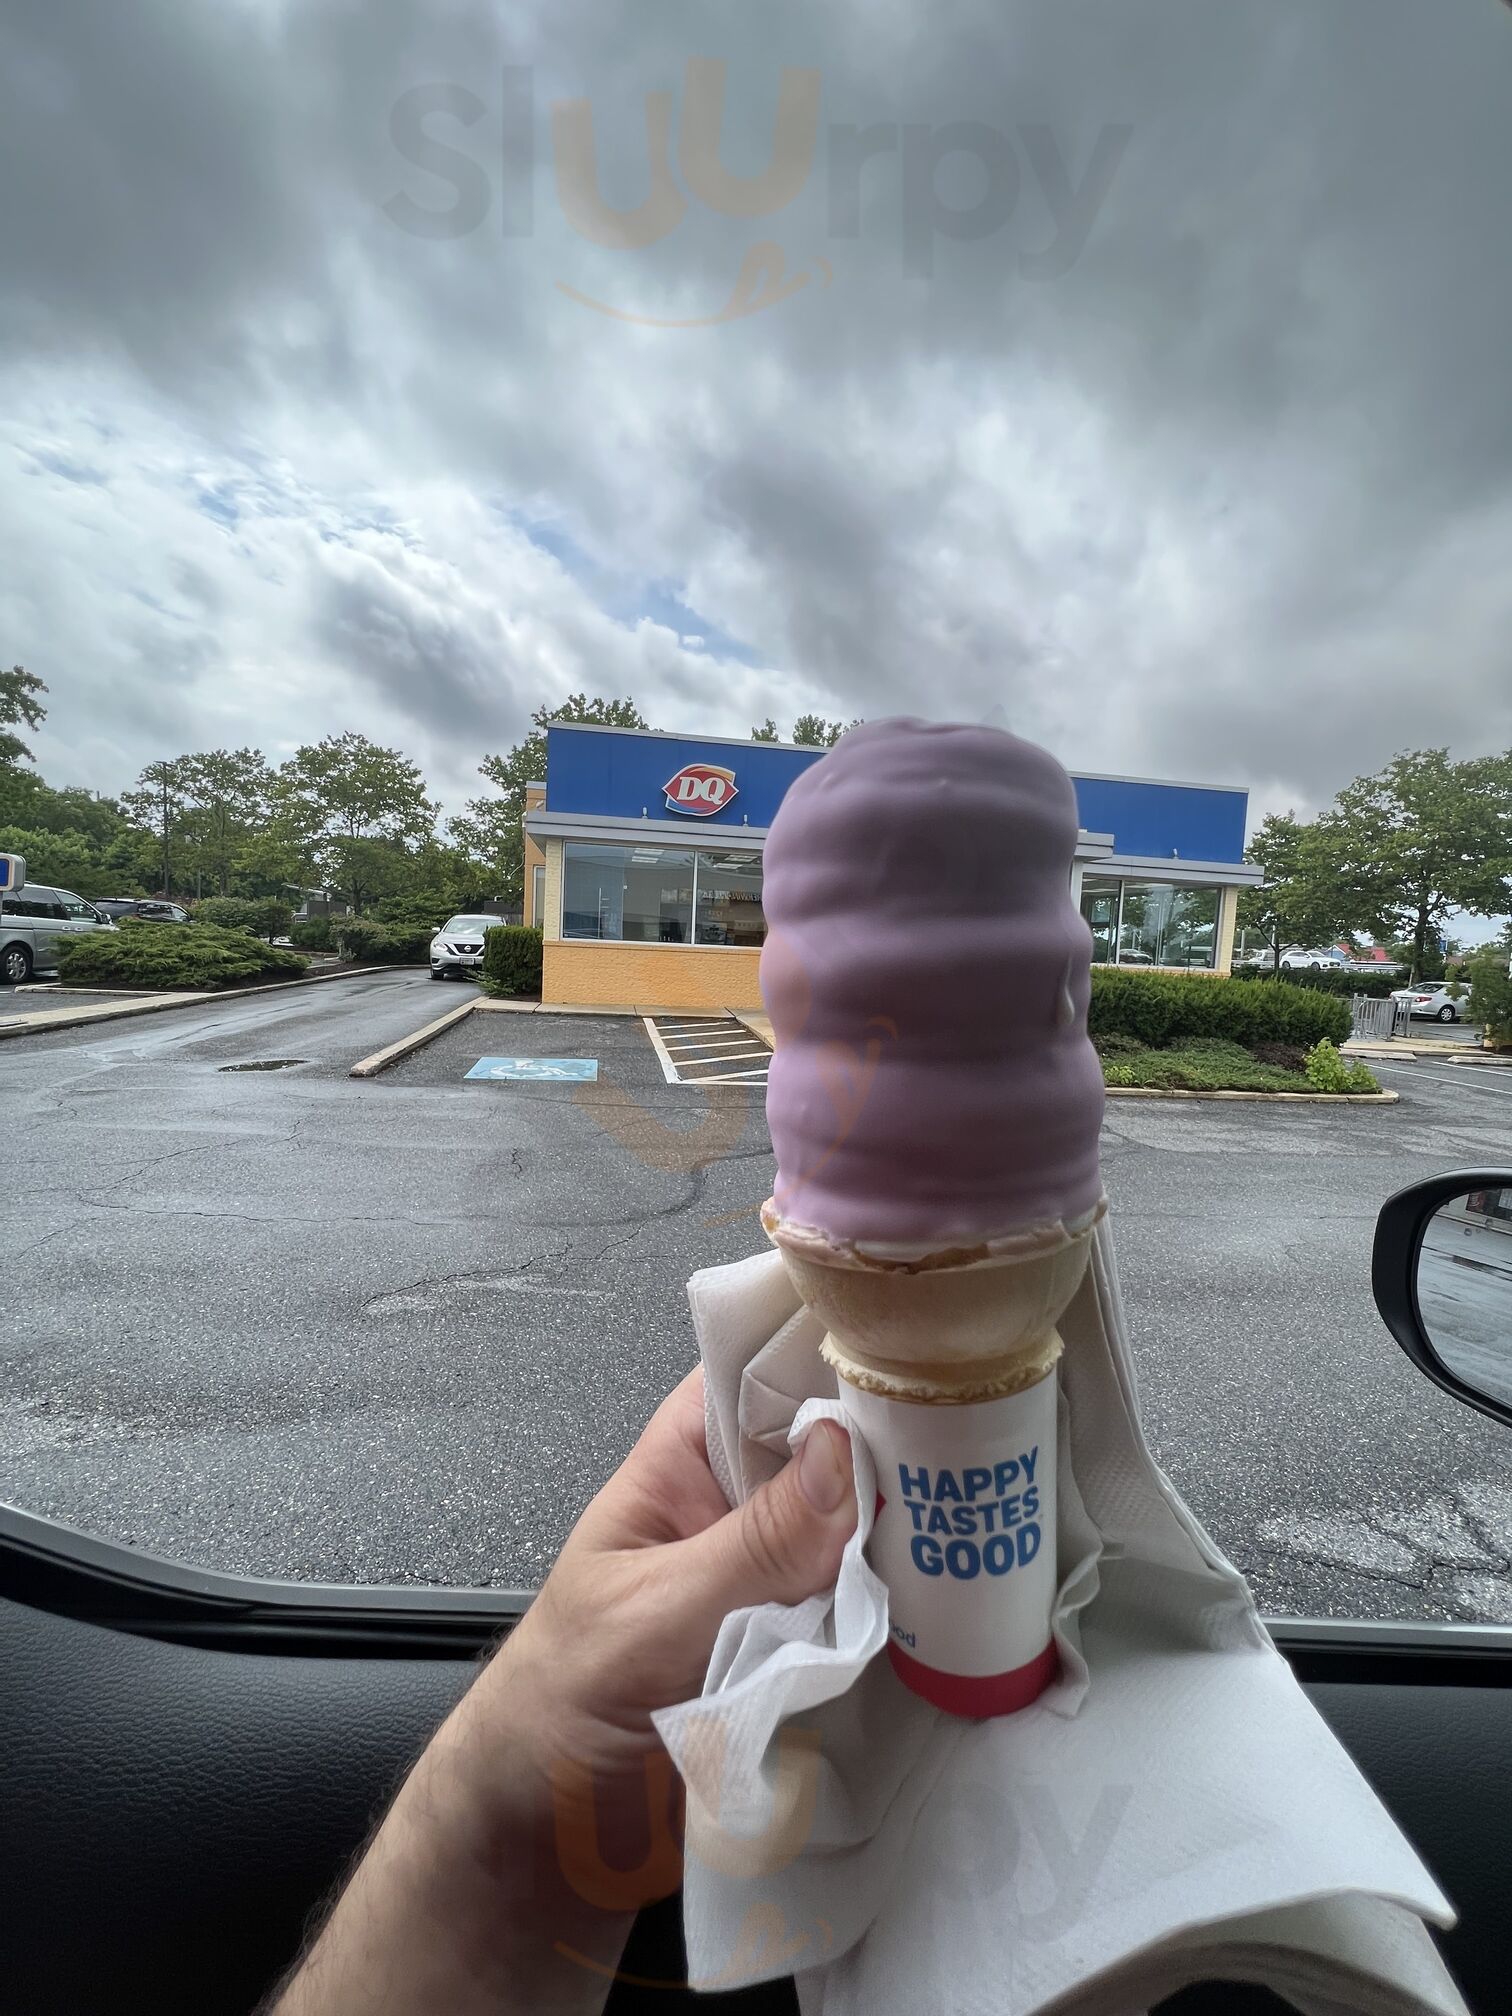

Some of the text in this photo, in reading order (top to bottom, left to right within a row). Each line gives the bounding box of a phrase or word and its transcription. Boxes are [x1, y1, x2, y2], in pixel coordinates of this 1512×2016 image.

[677, 776, 726, 805] DQ
[898, 1445, 1039, 1502] HAPPY
[903, 1485, 1040, 1537] TASTES
[911, 1521, 1042, 1580] GOOD
